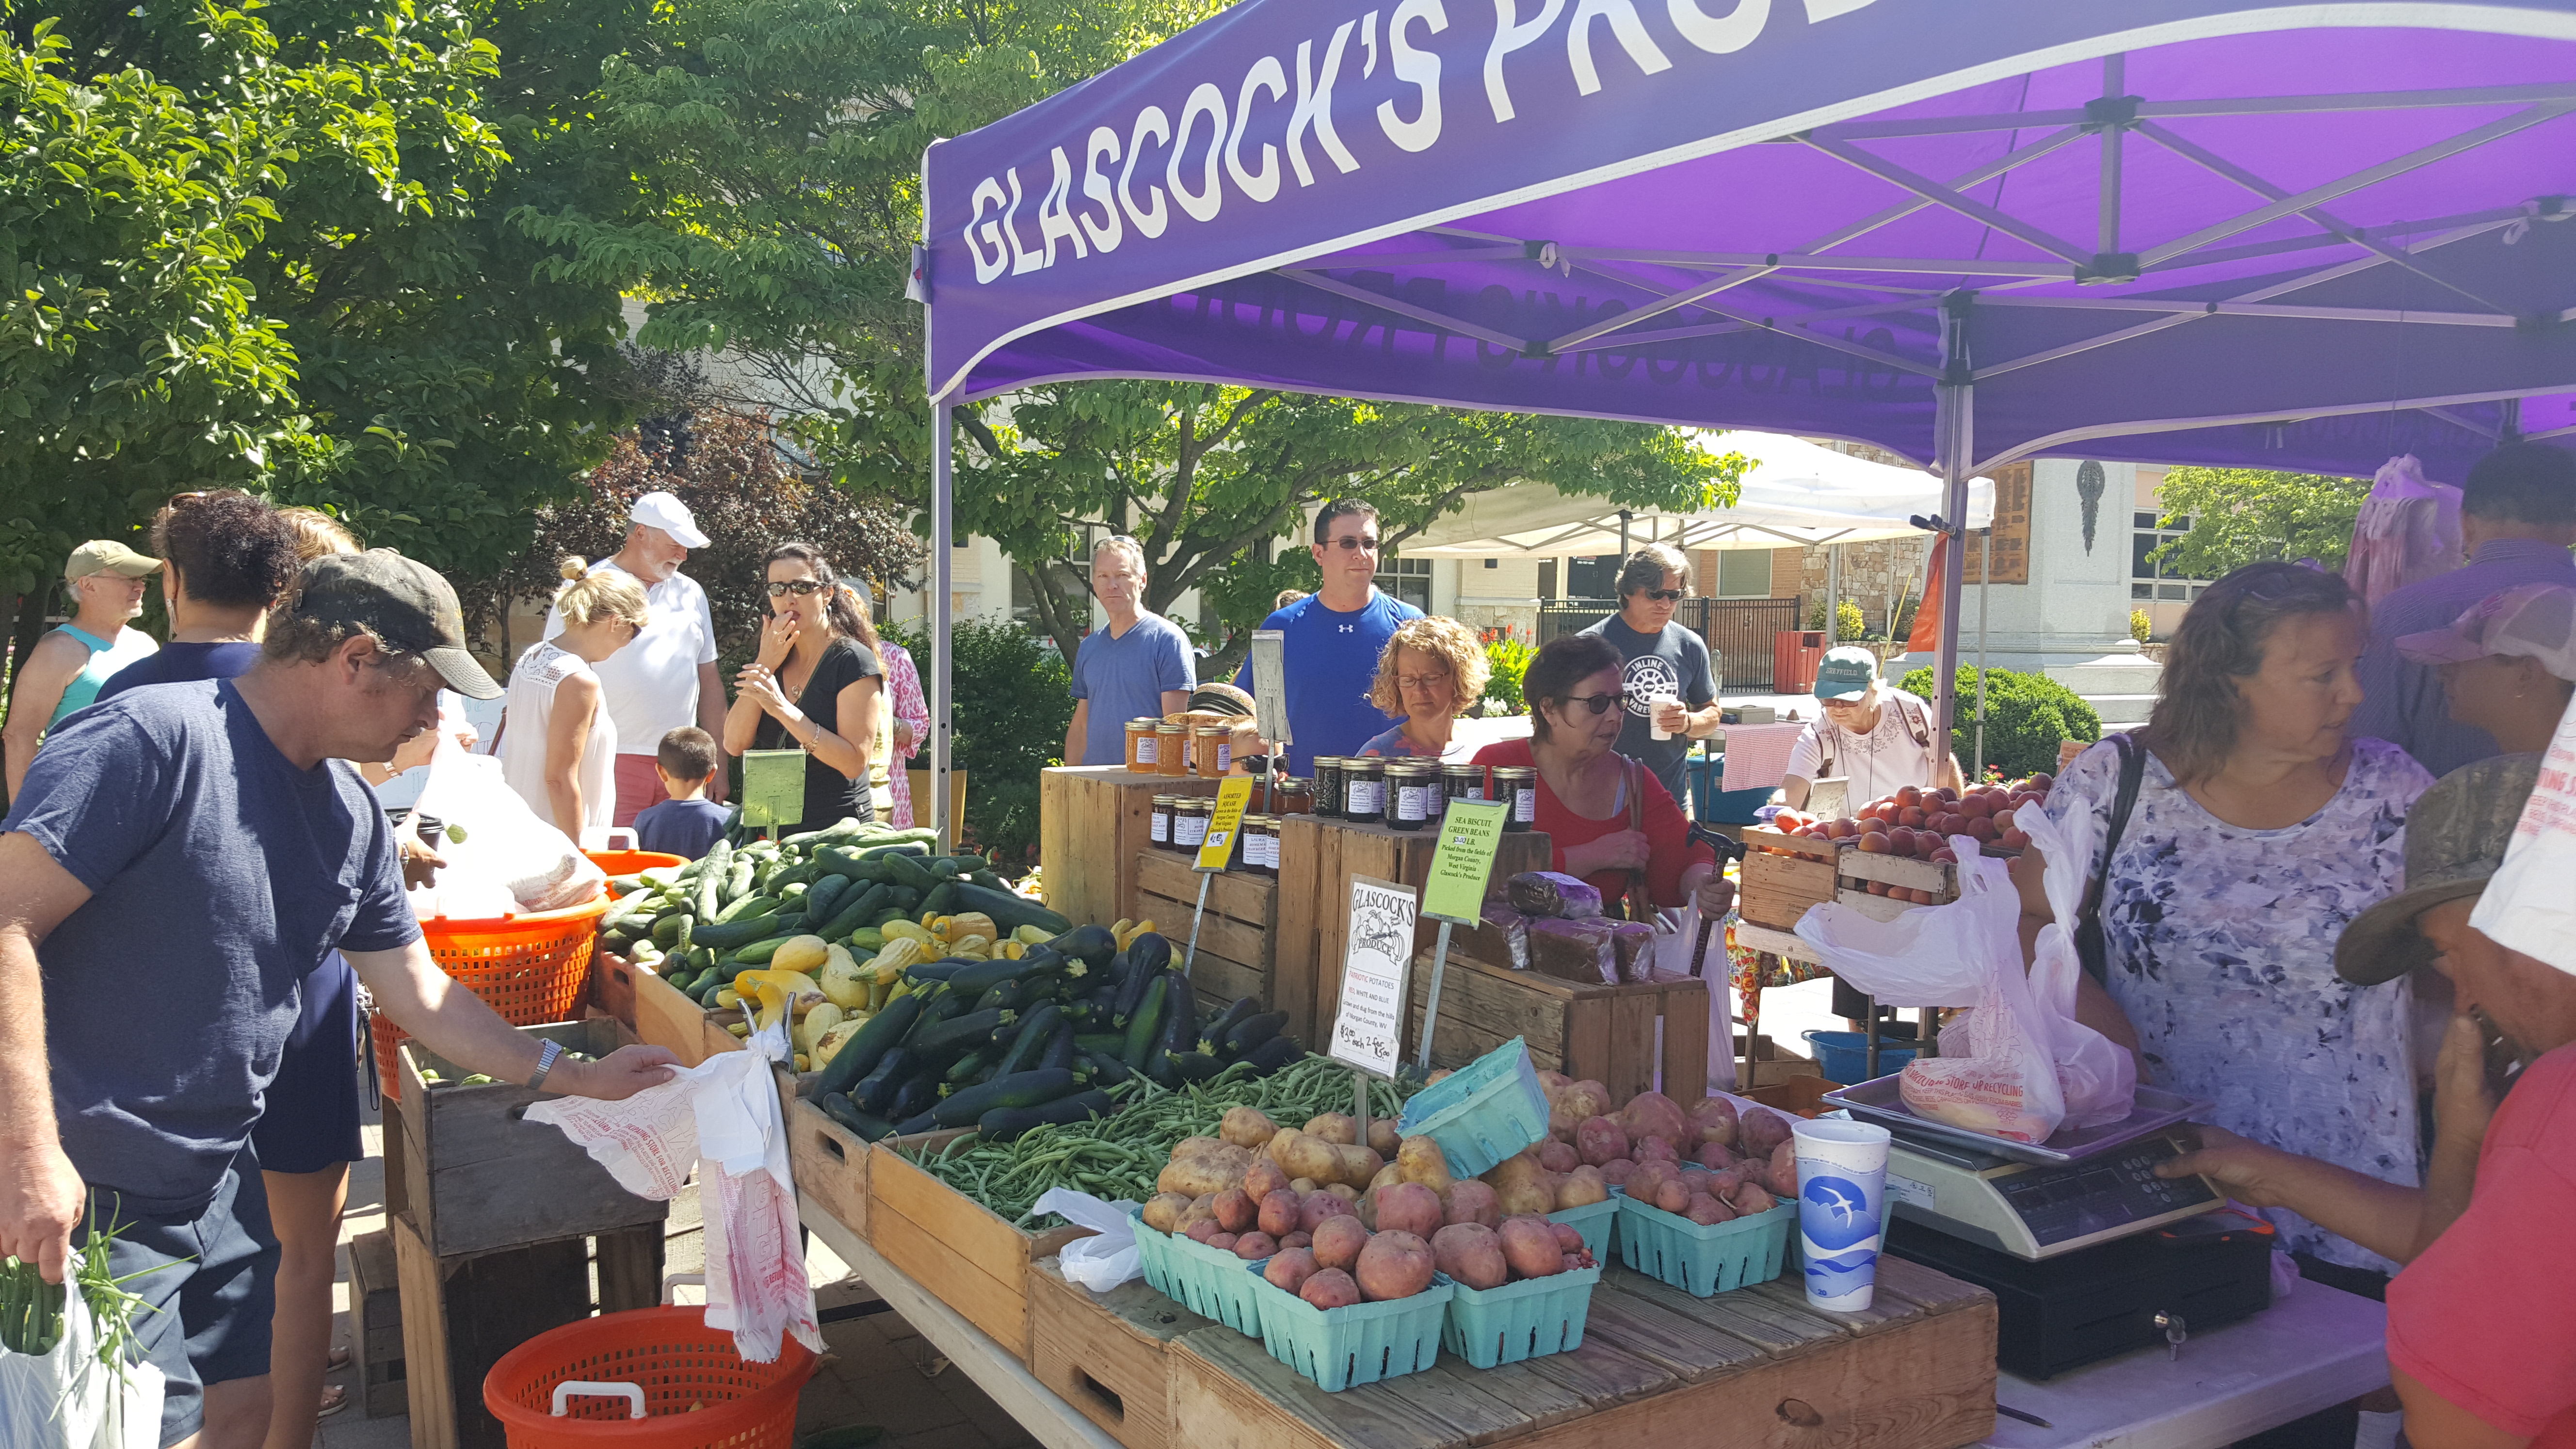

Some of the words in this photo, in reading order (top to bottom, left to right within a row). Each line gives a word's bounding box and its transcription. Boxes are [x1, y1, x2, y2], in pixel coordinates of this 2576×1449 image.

[963, 0, 1449, 284] GLASCOCK'S
[1631, 659, 1663, 672] INLINE
[1467, 818, 1492, 827] BISCUIT
[1449, 826, 1469, 834] GREEN
[1470, 828, 1490, 837] BEANS
[1460, 864, 1476, 872] Virginia
[1353, 889, 1414, 927] GLASCOCK'S
[1359, 939, 1391, 954] PRODUCE
[1349, 970, 1368, 982] PATRIOTIC
[1369, 977, 1394, 989] POTATOES
[1356, 989, 1368, 998] WHITE
[1350, 1013, 1362, 1022] Morgan
[1363, 1017, 1378, 1028] County,
[1352, 1037, 1364, 1049] each
[1367, 1036, 1371, 1046] 2
[1372, 1037, 1384, 1048] for
[1984, 1081, 2023, 1096] RECYCLING
[640, 1147, 651, 1161] PLASTIC
[646, 1139, 661, 1156] STORE
[656, 1155, 666, 1166] FOR
[662, 1166, 678, 1194] RECYCLING
